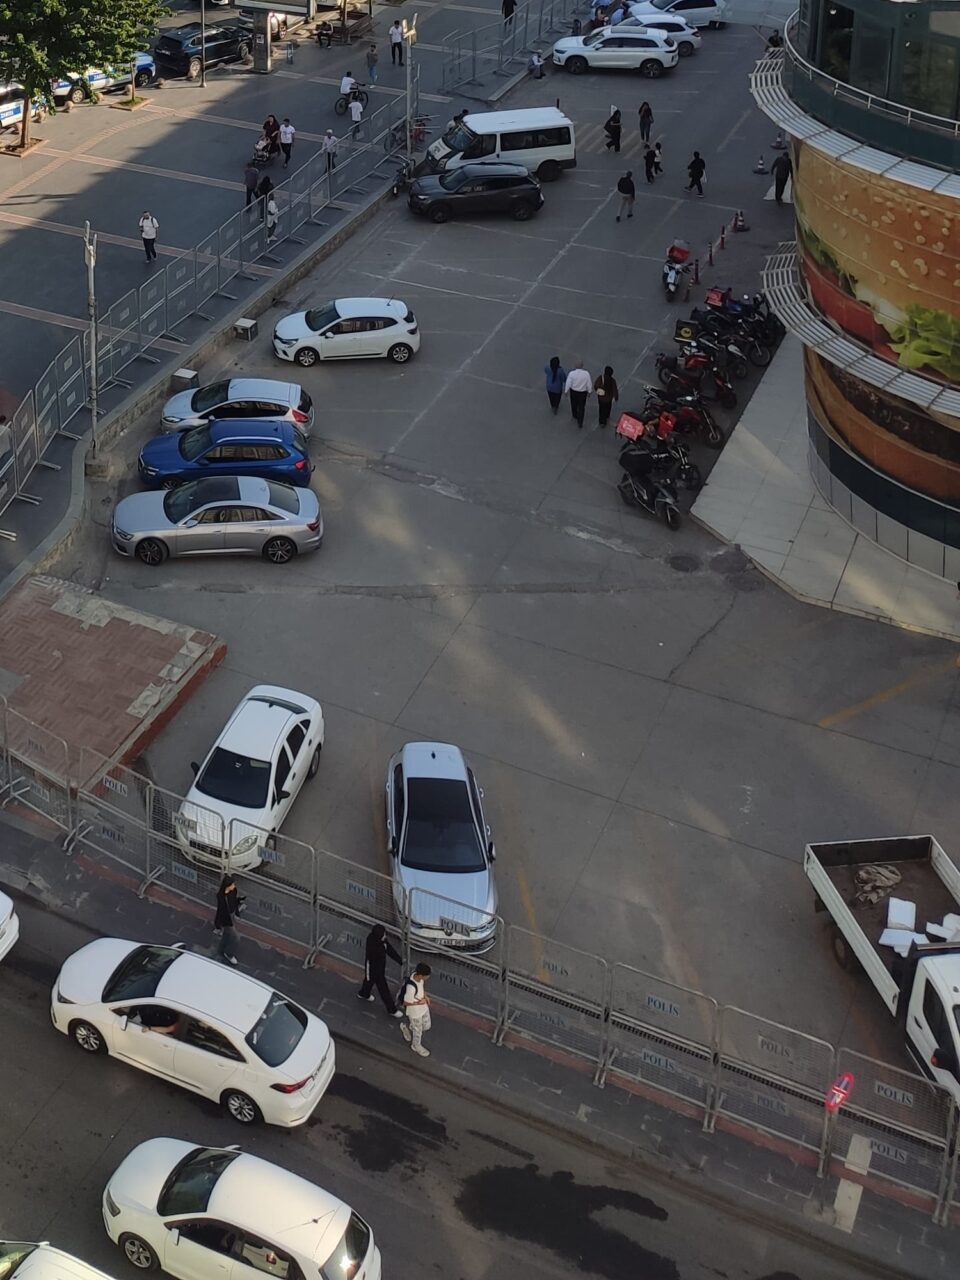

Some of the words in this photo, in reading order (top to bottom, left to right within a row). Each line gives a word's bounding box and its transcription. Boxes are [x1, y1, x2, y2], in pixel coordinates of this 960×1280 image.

[348, 881, 375, 899] POLİS
[440, 919, 470, 937] POLİS
[543, 958, 569, 976] POLİS
[647, 995, 680, 1017] POLİS
[759, 1038, 791, 1058] POLİS
[643, 1050, 675, 1071] POLİS
[756, 1095, 787, 1114] POLİS
[877, 1083, 912, 1106] POLİS
[870, 1139, 906, 1162] POLİS
